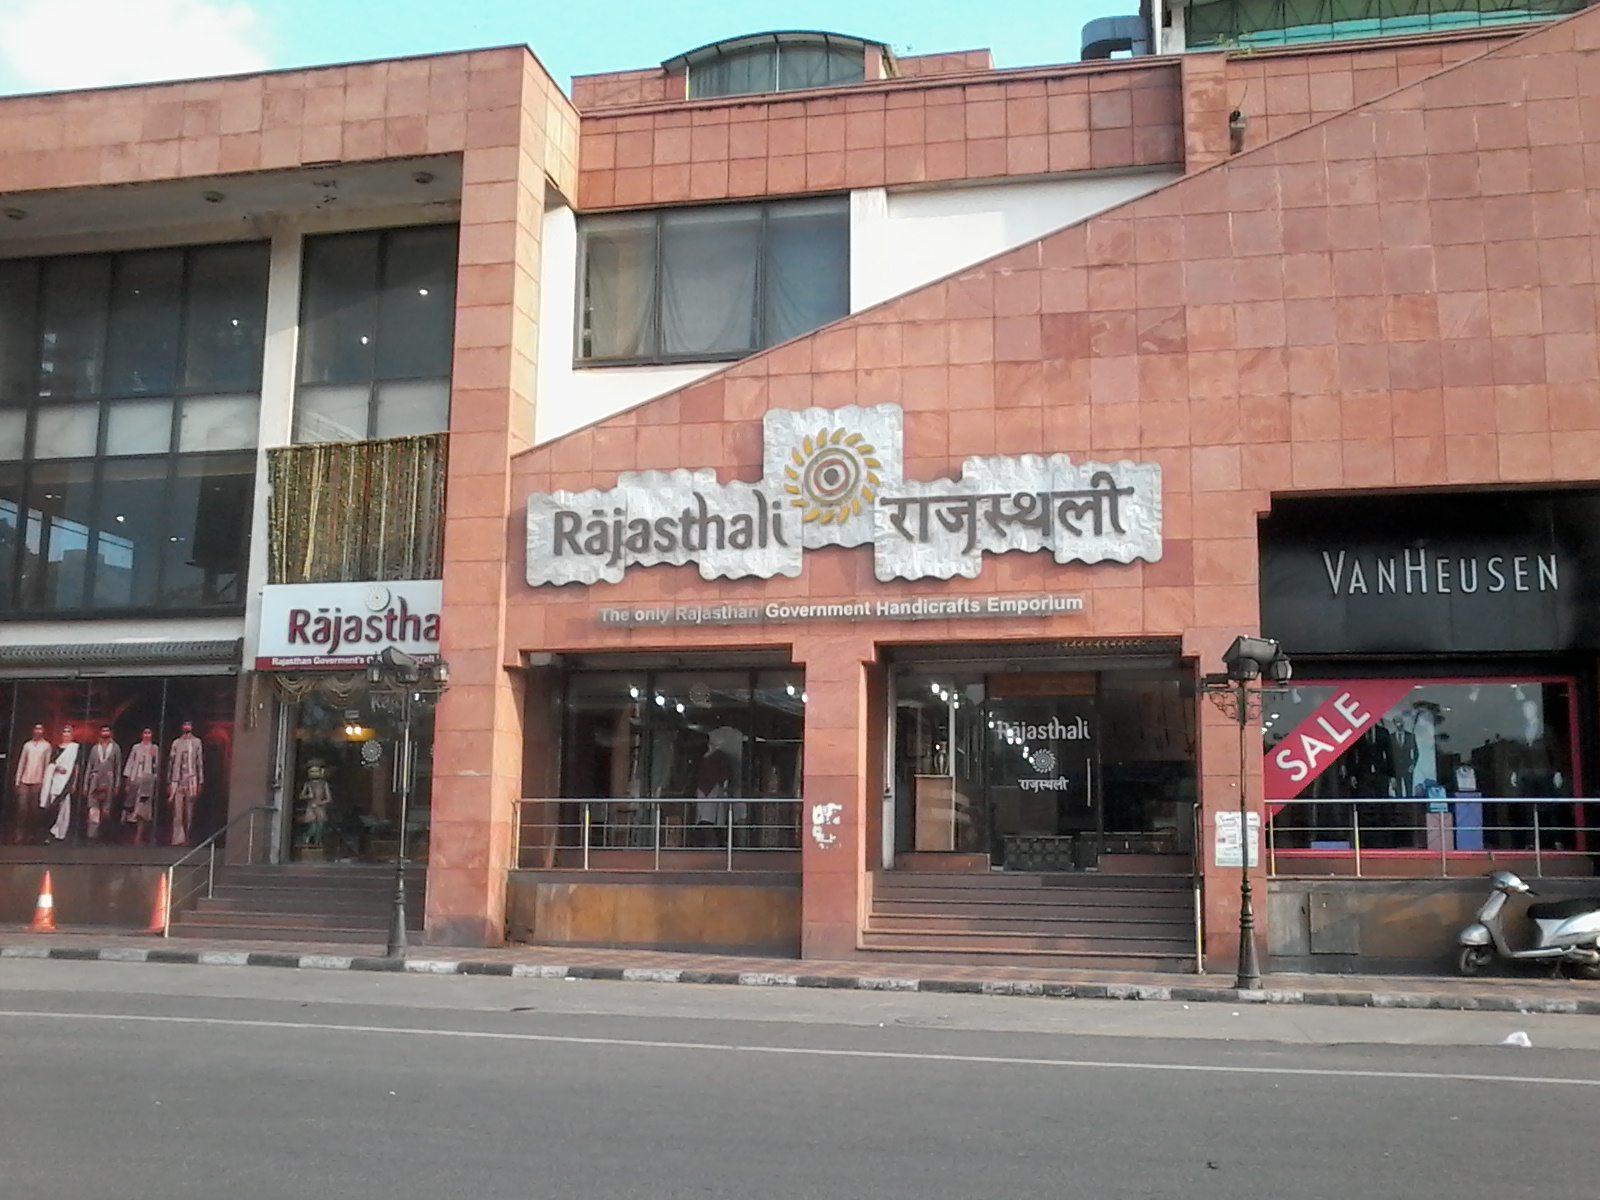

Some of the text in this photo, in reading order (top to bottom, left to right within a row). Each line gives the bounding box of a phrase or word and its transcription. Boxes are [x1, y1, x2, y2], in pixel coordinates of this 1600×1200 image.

[553, 489, 788, 567] Rājasthali
[879, 471, 1135, 554] राजस्थली
[600, 595, 1083, 624] The only Rajasthan Government Handicrafts Emporium
[271, 657, 312, 667] Rajasthan
[1276, 692, 1371, 782] SALE
[1017, 775, 1069, 793] राजस्थली
